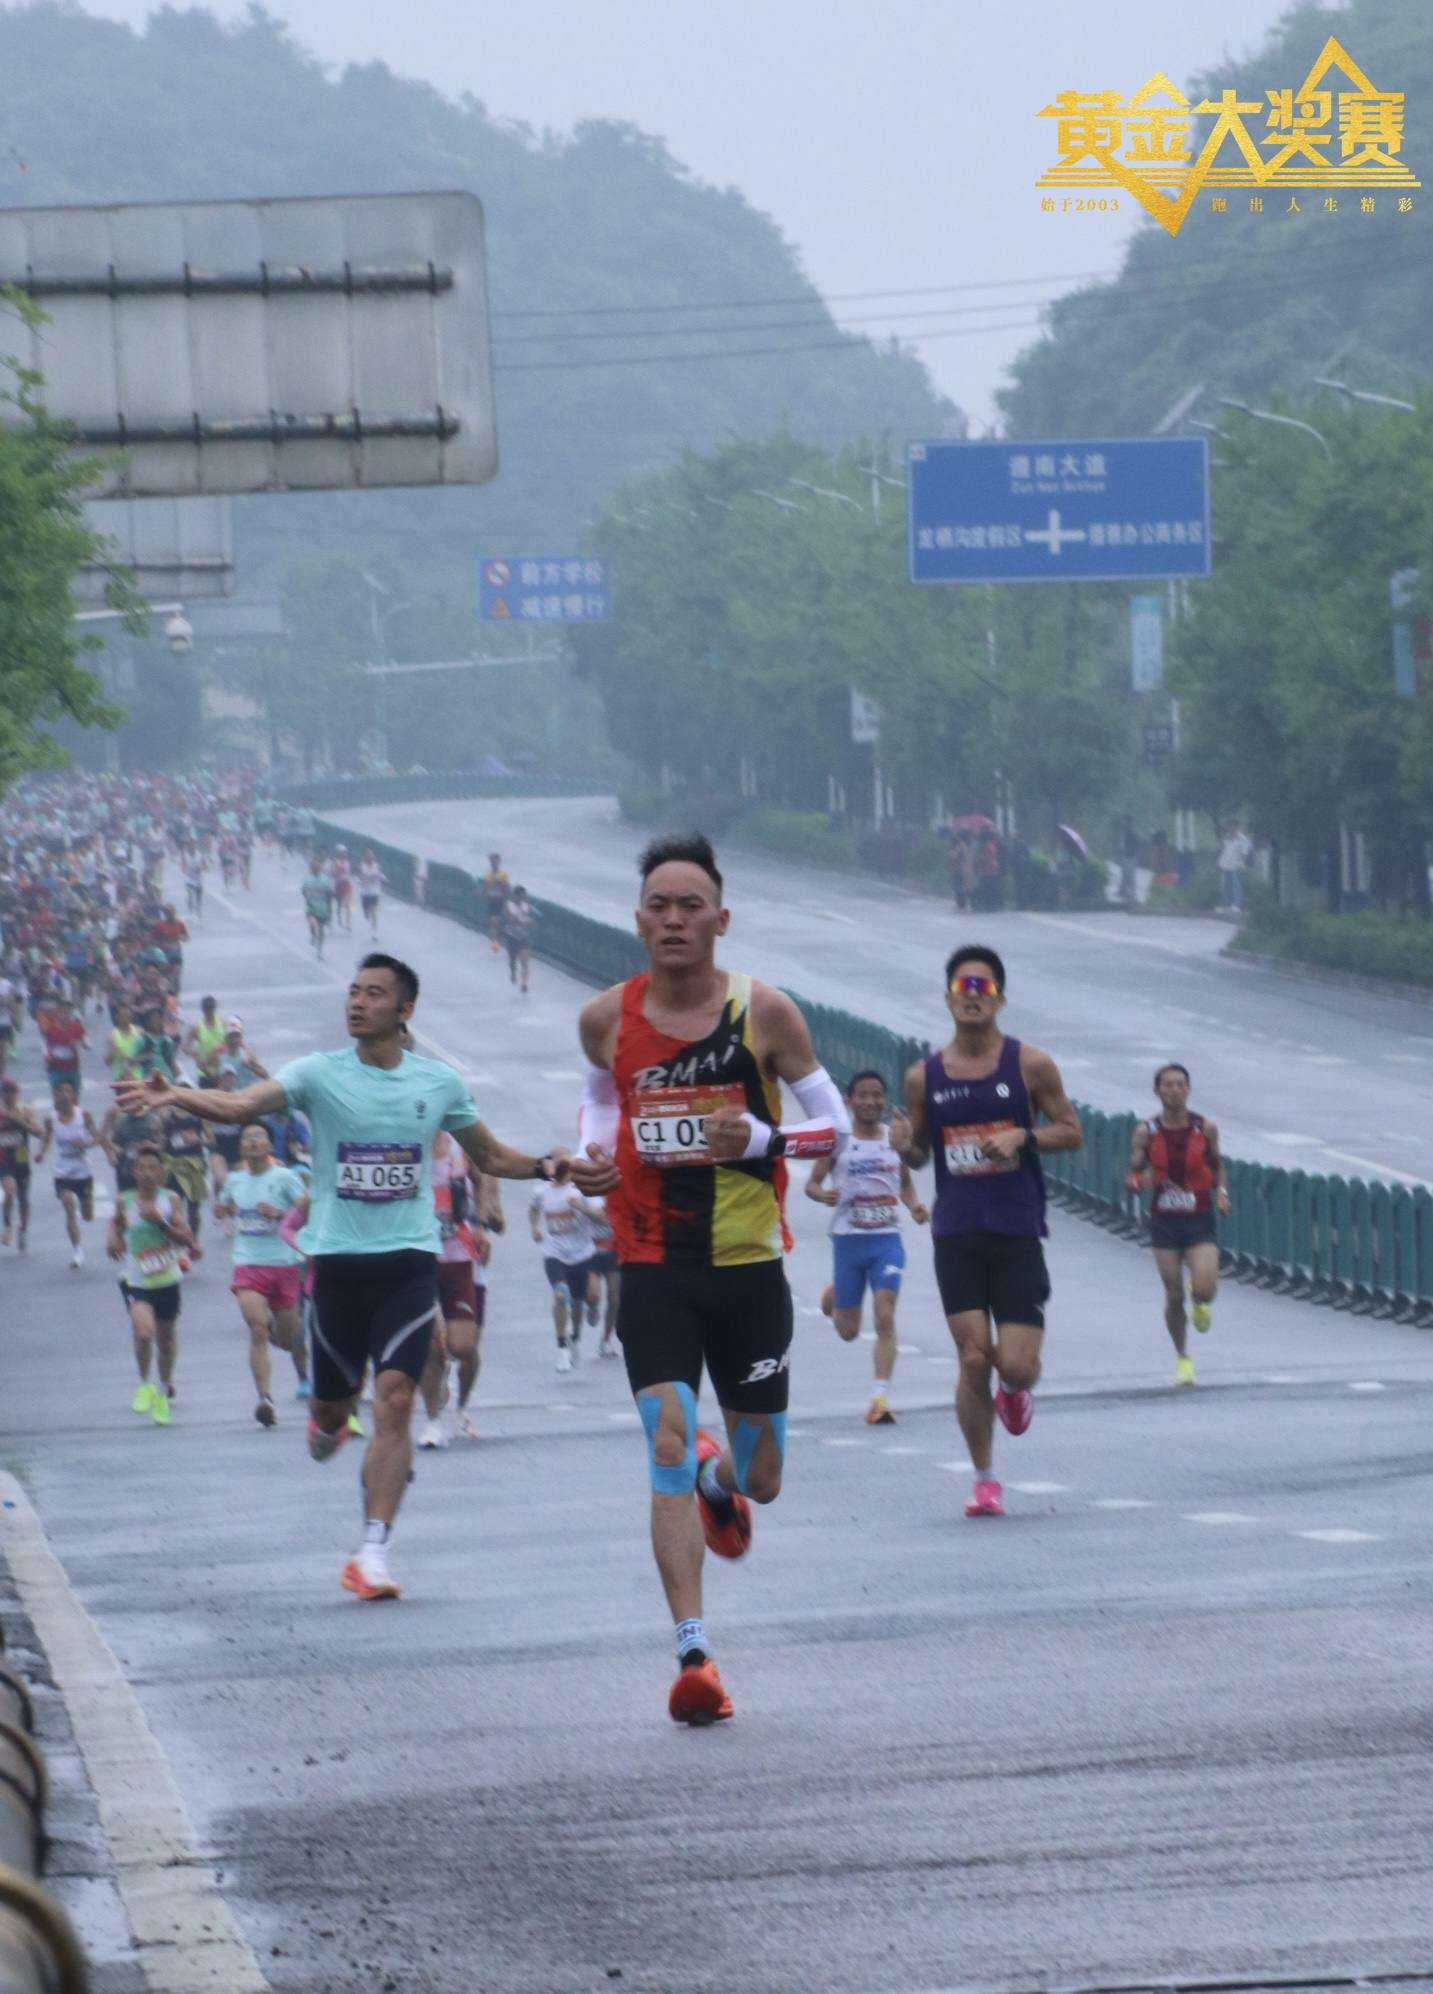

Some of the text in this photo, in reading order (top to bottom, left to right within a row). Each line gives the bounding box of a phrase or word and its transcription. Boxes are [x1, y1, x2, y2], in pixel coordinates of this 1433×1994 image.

[637, 1121, 666, 1143] C1
[341, 1166, 415, 1187] A1 065
